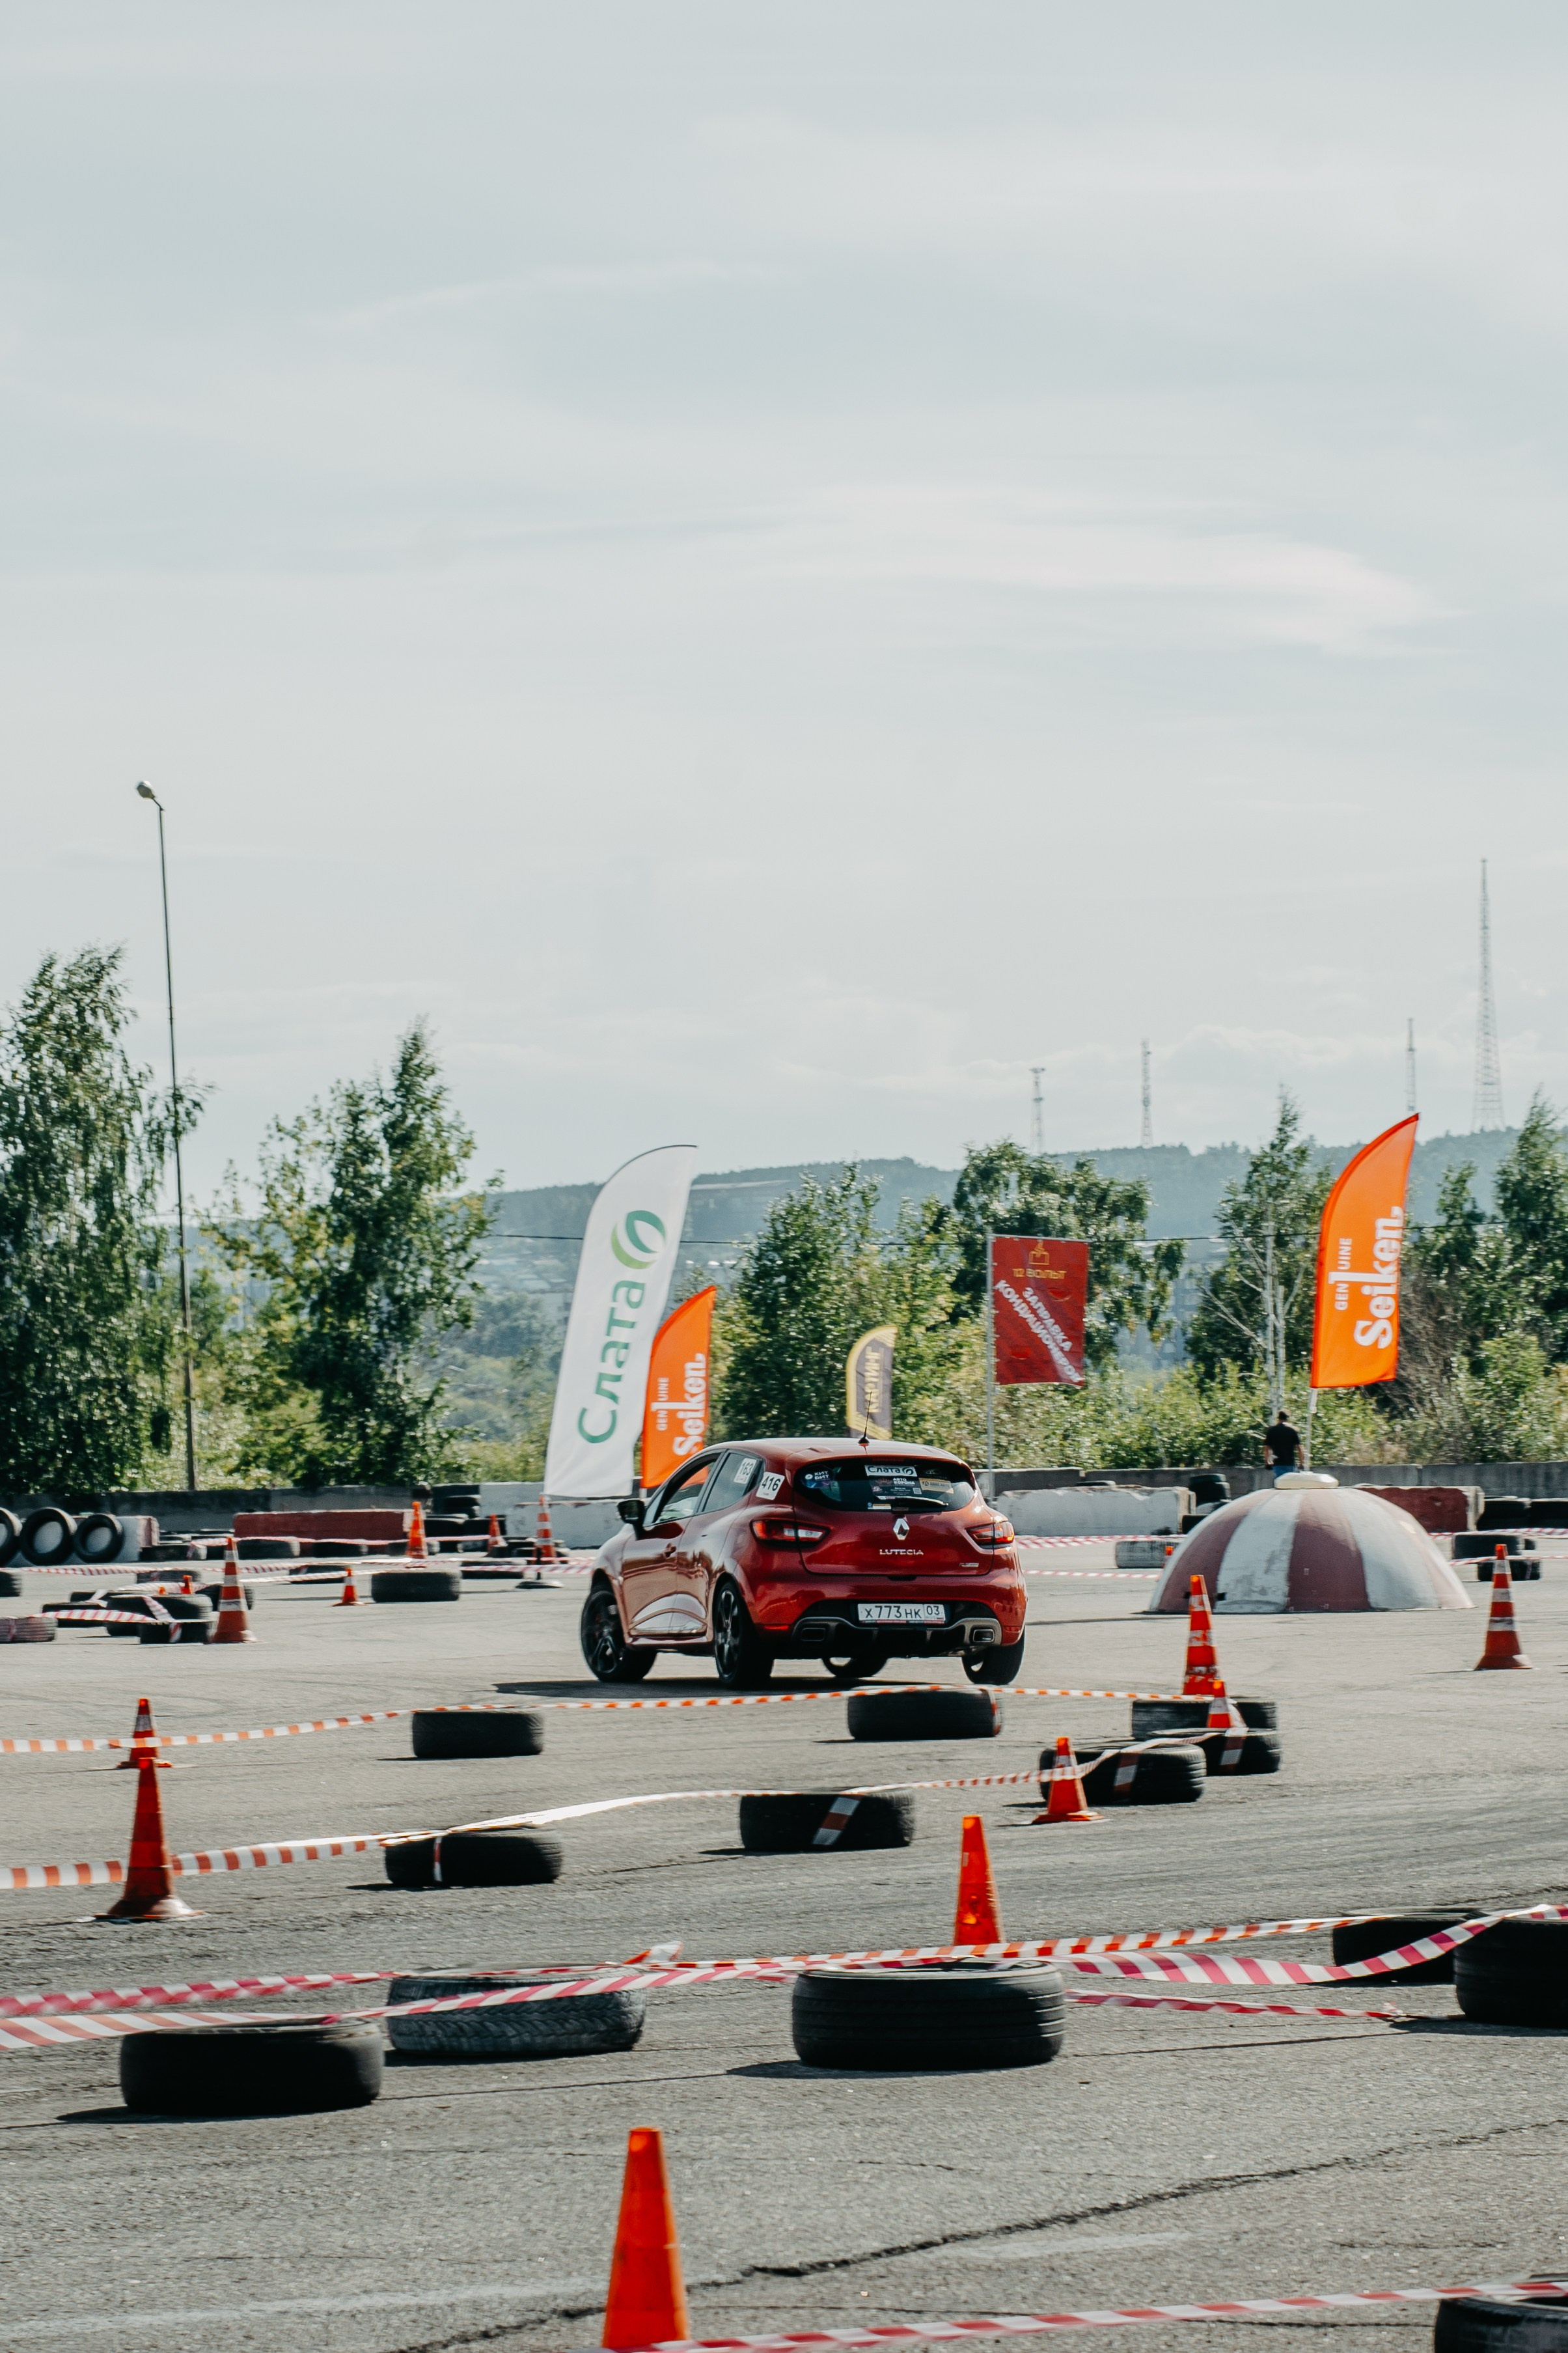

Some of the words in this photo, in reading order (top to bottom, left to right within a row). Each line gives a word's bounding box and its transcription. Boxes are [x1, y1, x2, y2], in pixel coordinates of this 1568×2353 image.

[1012, 1268, 1025, 1277] 12
[1026, 1269, 1067, 1279] ВОЛЬТ
[1022, 1287, 1073, 1352] ЗАПРАВКА
[577, 1280, 647, 1444] Слата
[864, 1346, 883, 1413] КАРТИНГ
[739, 1462, 754, 1476] 163
[867, 1465, 901, 1473] Слата
[761, 1475, 781, 1492] 416
[926, 1605, 940, 1615] 03
